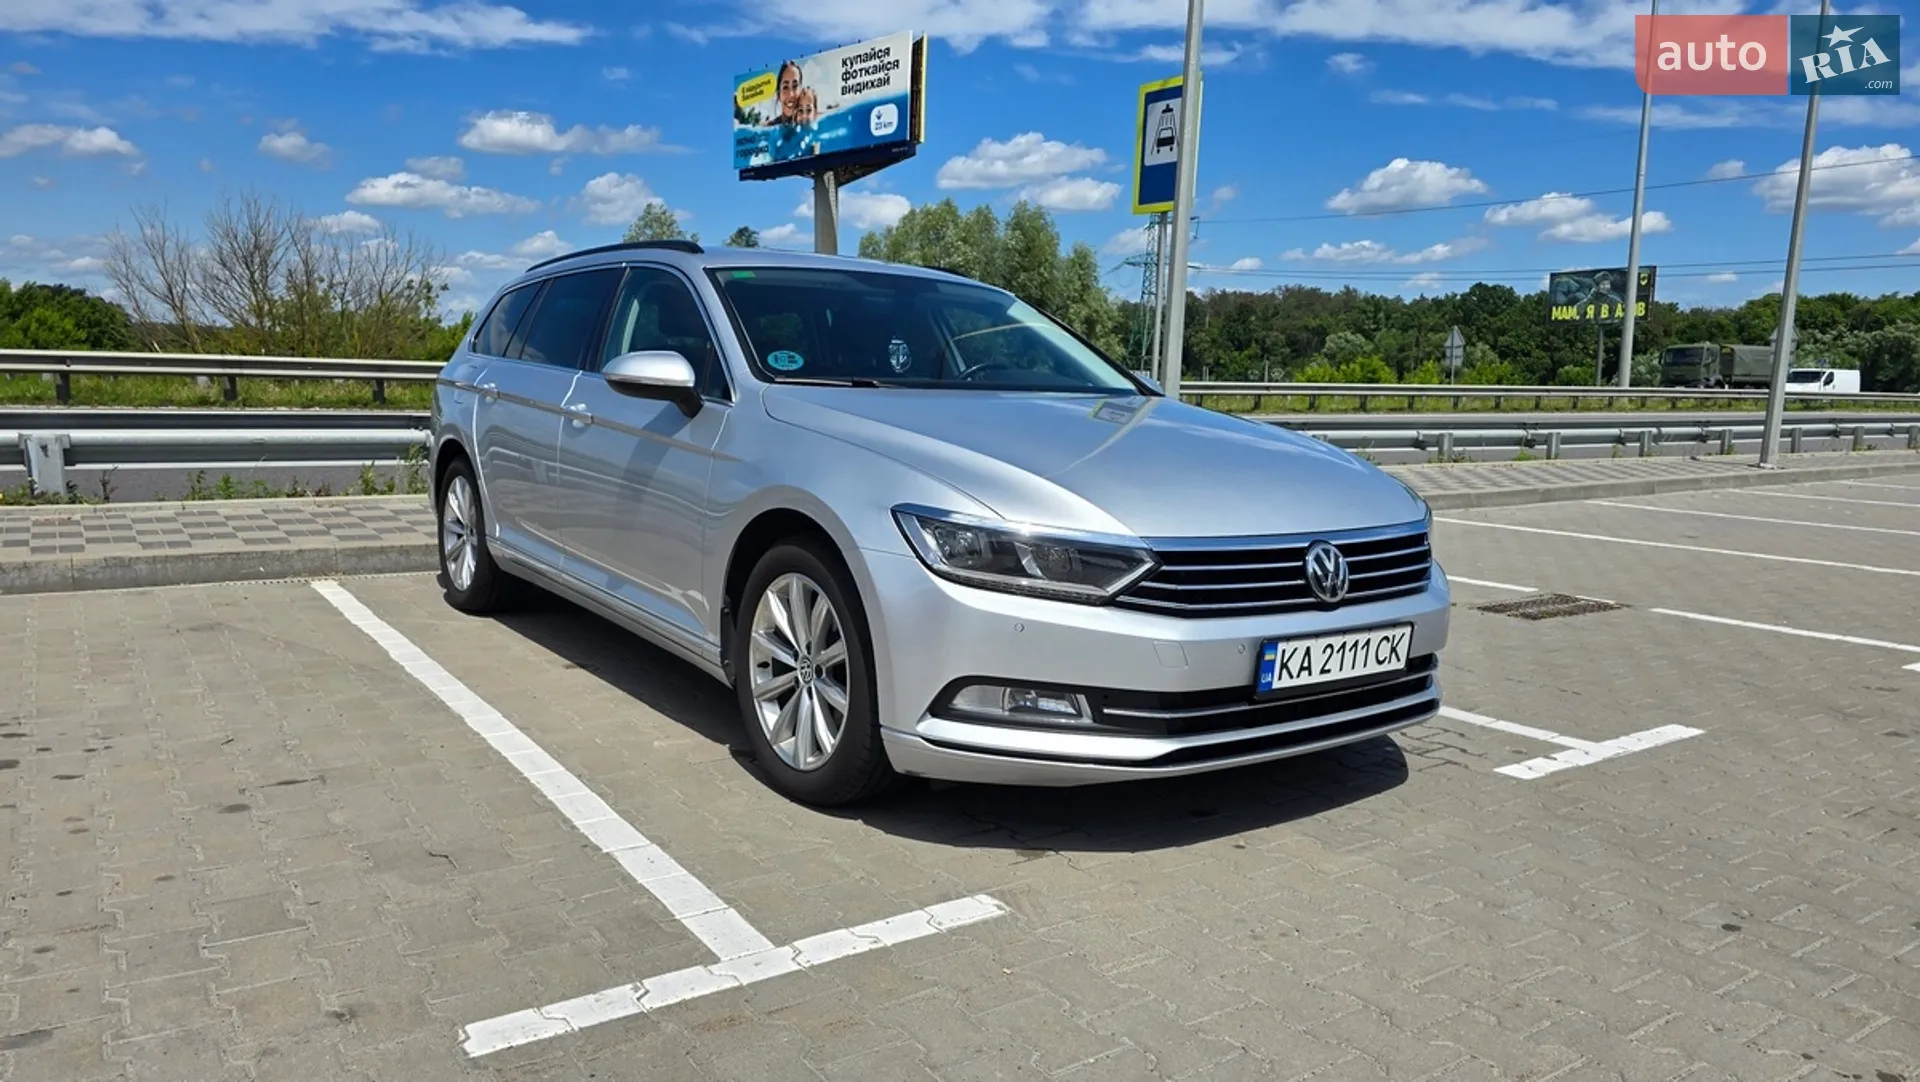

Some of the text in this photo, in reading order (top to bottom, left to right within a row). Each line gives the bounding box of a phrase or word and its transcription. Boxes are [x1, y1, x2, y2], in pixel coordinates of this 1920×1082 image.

[841, 46, 891, 70] купайся
[841, 59, 900, 84] фоткайся
[841, 72, 891, 95] видихай
[1585, 304, 1595, 319] Я
[1600, 304, 1609, 319] В
[1260, 632, 1406, 683] UA KA 2111 CK
